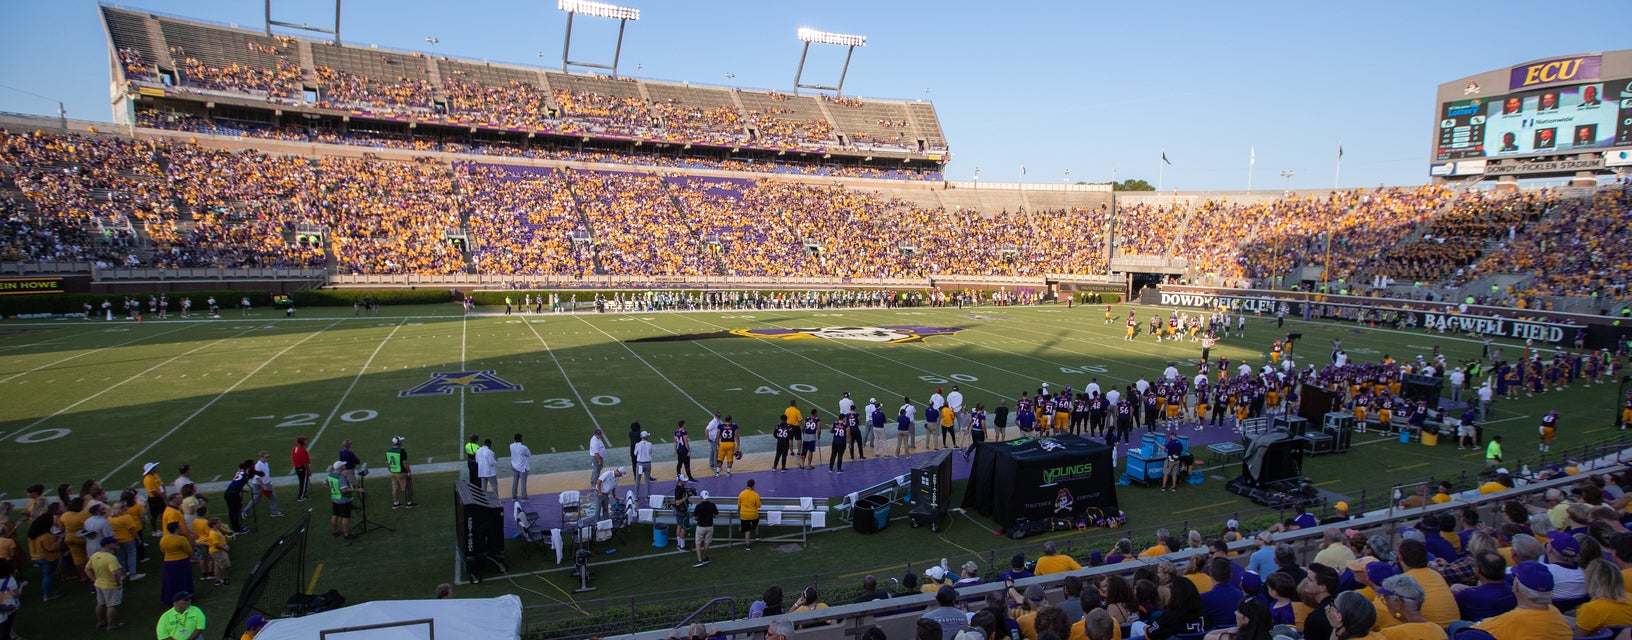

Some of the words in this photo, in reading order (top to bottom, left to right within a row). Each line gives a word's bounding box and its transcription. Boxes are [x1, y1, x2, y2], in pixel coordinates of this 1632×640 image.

[1523, 59, 1584, 86] ECU
[1536, 116, 1575, 125] Nationwide
[1560, 159, 1600, 170] STADIUM
[20, 281, 58, 289] HOWE
[1424, 313, 1507, 336] BAGWELL
[1512, 322, 1564, 342] FIELD
[1119, 406, 1129, 415] 56
[805, 422, 816, 431] 90
[722, 429, 733, 439] 63
[777, 428, 788, 438] 26
[834, 427, 844, 437] 78
[1043, 463, 1093, 484] YOUNGS
